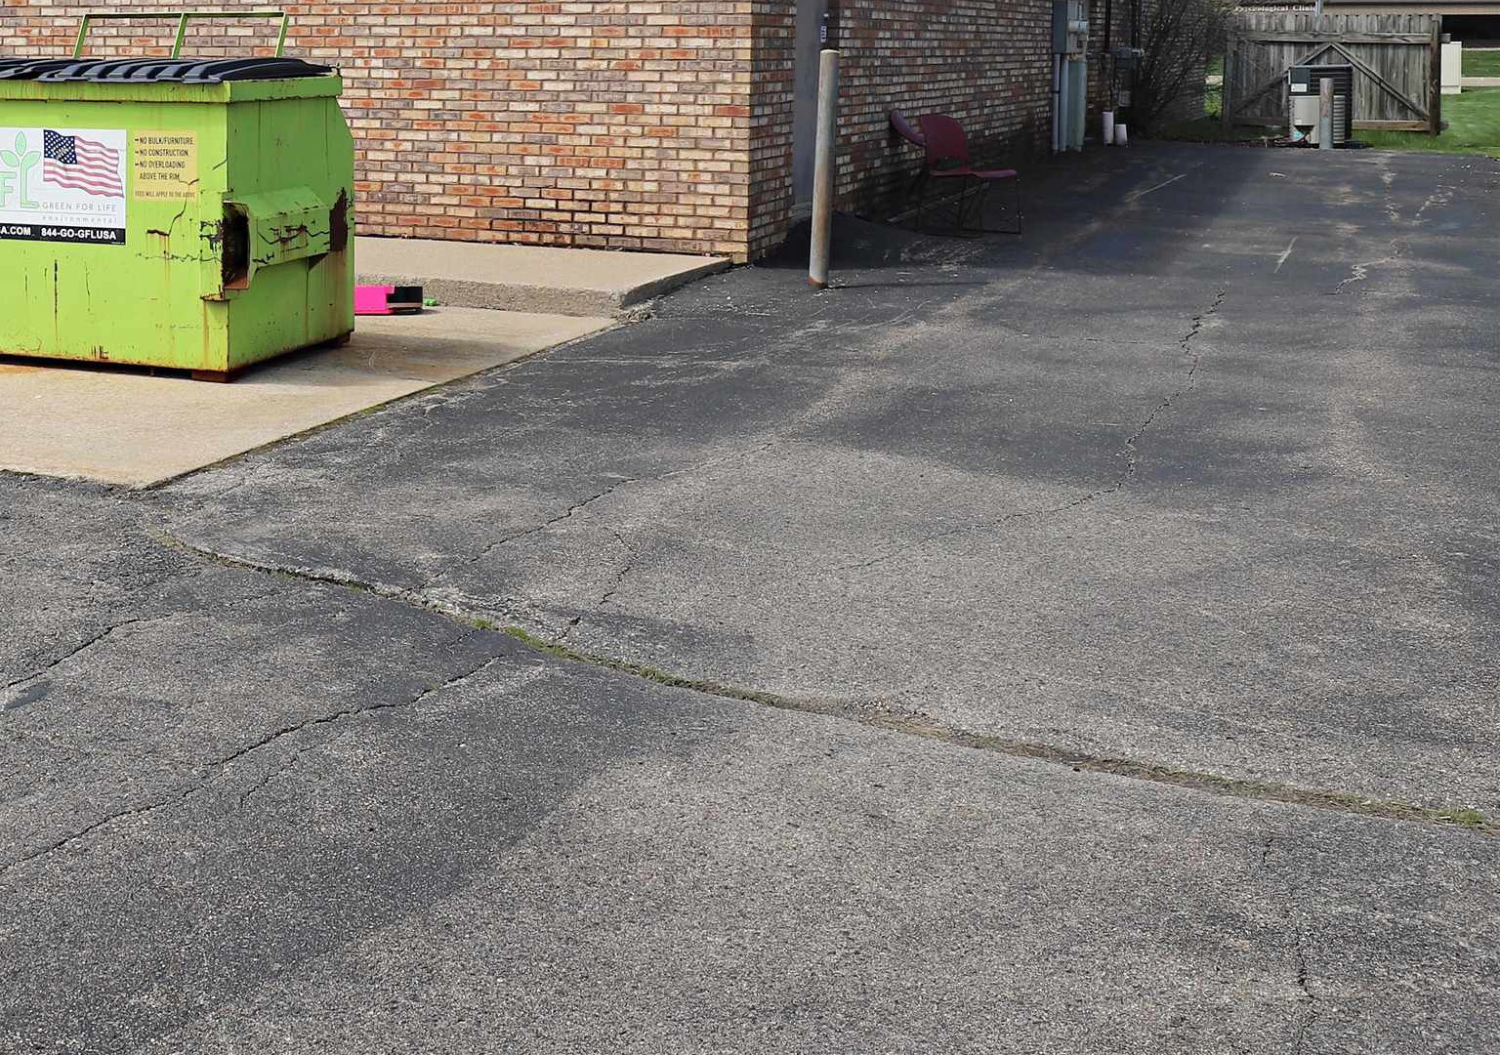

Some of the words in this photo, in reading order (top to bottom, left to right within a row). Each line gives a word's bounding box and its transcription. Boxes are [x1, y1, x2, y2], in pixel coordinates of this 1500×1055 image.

[42, 201, 72, 210] GREEN
[76, 202, 94, 211] FOR
[97, 203, 117, 212] LIFE
[42, 215, 117, 224] environmental
[41, 228, 117, 240] 844-GO-GFLUSA
